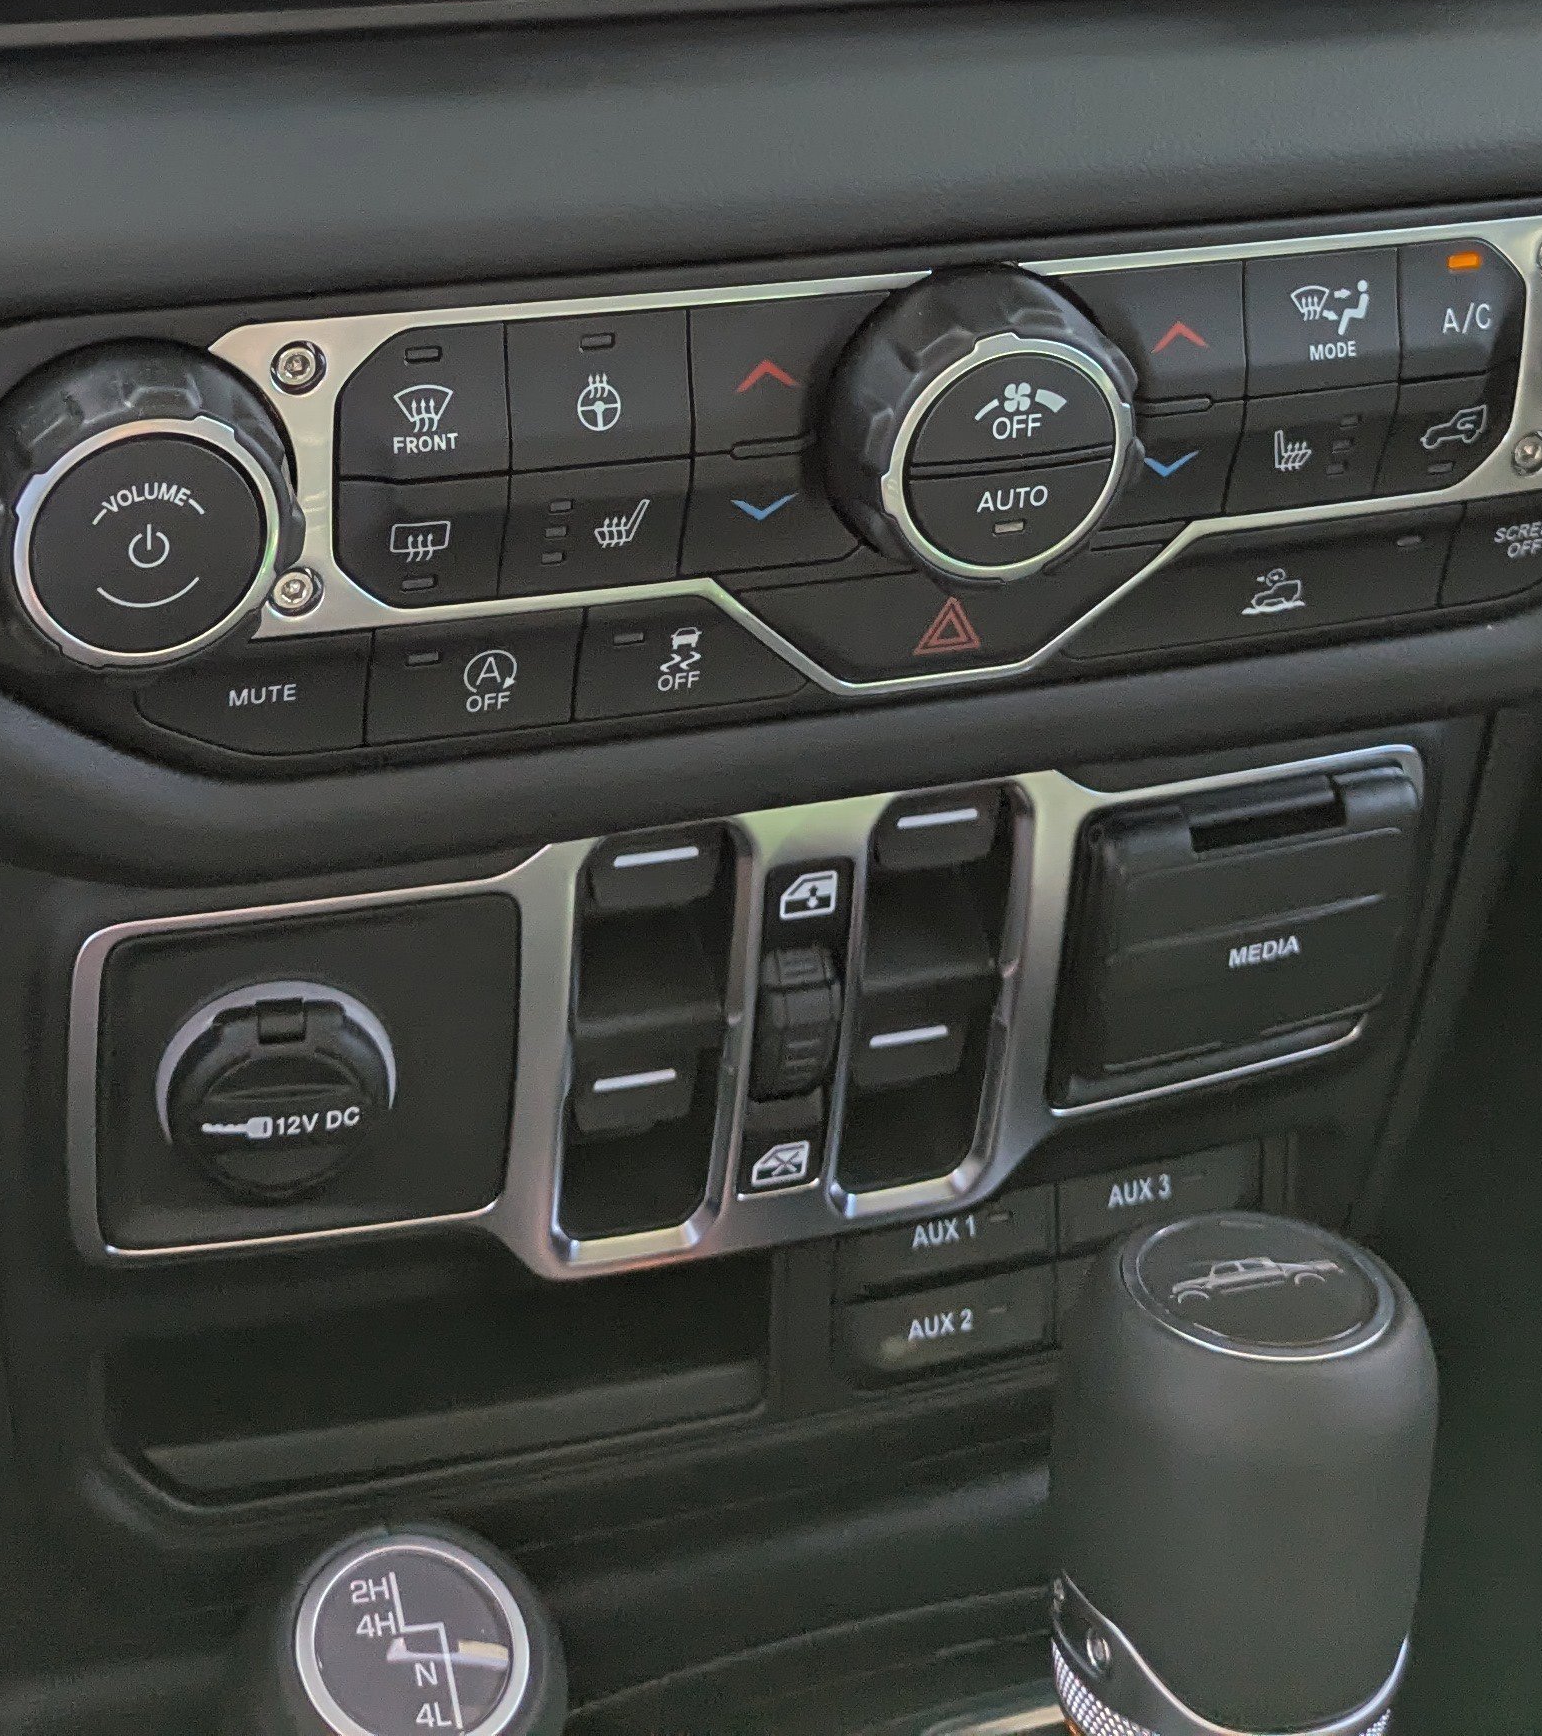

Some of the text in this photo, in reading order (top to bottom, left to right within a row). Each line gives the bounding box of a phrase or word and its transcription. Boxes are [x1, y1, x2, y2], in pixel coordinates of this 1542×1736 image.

[1442, 304, 1493, 334] A/C
[1309, 340, 1358, 362] MODE
[991, 414, 1042, 441] OFF
[392, 432, 459, 455] FRONT
[101, 482, 191, 514] VOLUME
[976, 485, 1049, 514] AUTO
[1507, 537, 1542, 557] OFF
[227, 684, 298, 707] MUTE
[657, 671, 701, 693] OFF
[465, 693, 512, 713] OFF
[1227, 935, 1301, 969] MEDIA
[275, 1106, 360, 1136] 12V DC
[1108, 1174, 1172, 1208] AUX 3
[912, 1215, 977, 1249] AUX 1
[908, 1309, 973, 1342] AUX 2
[350, 1577, 390, 1604] 2H
[356, 1612, 397, 1637] 4H
[414, 1662, 438, 1687] N
[415, 1702, 453, 1728] 4L
